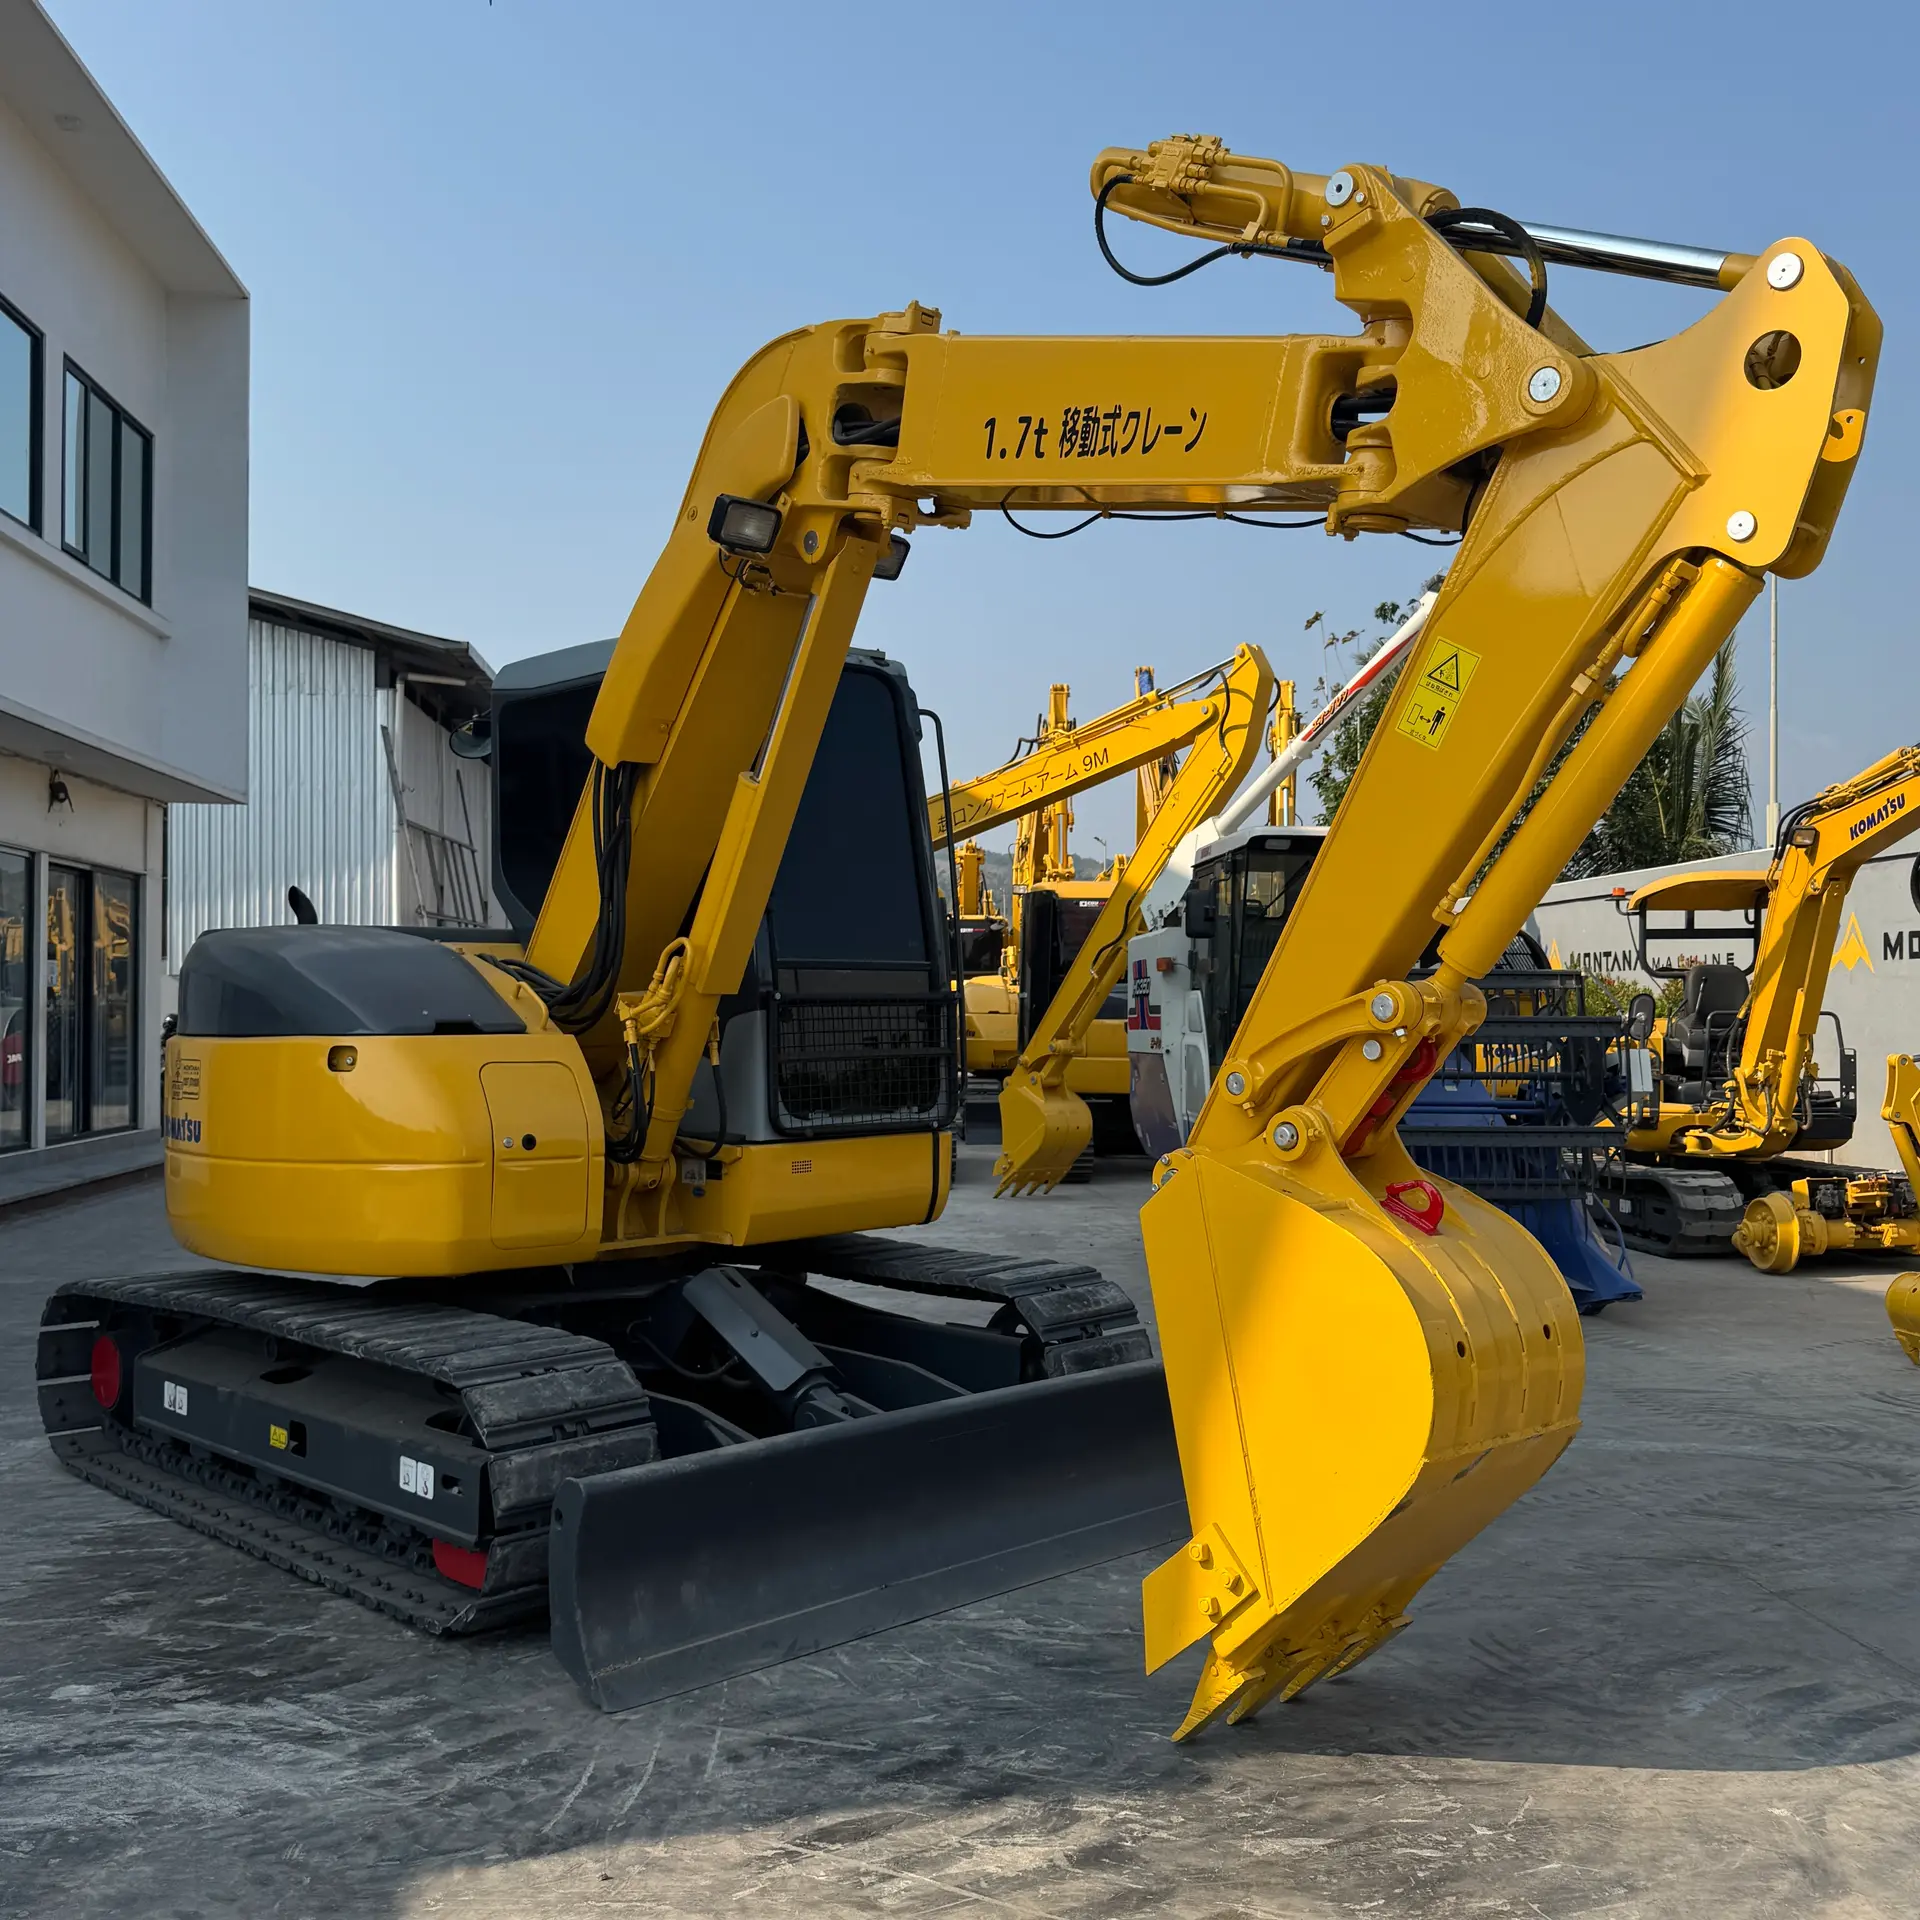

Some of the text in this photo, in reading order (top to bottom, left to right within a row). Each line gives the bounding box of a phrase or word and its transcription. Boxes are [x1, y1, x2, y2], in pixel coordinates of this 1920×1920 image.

[984, 403, 1208, 460] 1.7t 移動式クレーン
[1082, 748, 1109, 772] 9M
[1849, 792, 1906, 841] KOMATSU
[165, 1112, 201, 1144] MATSU
